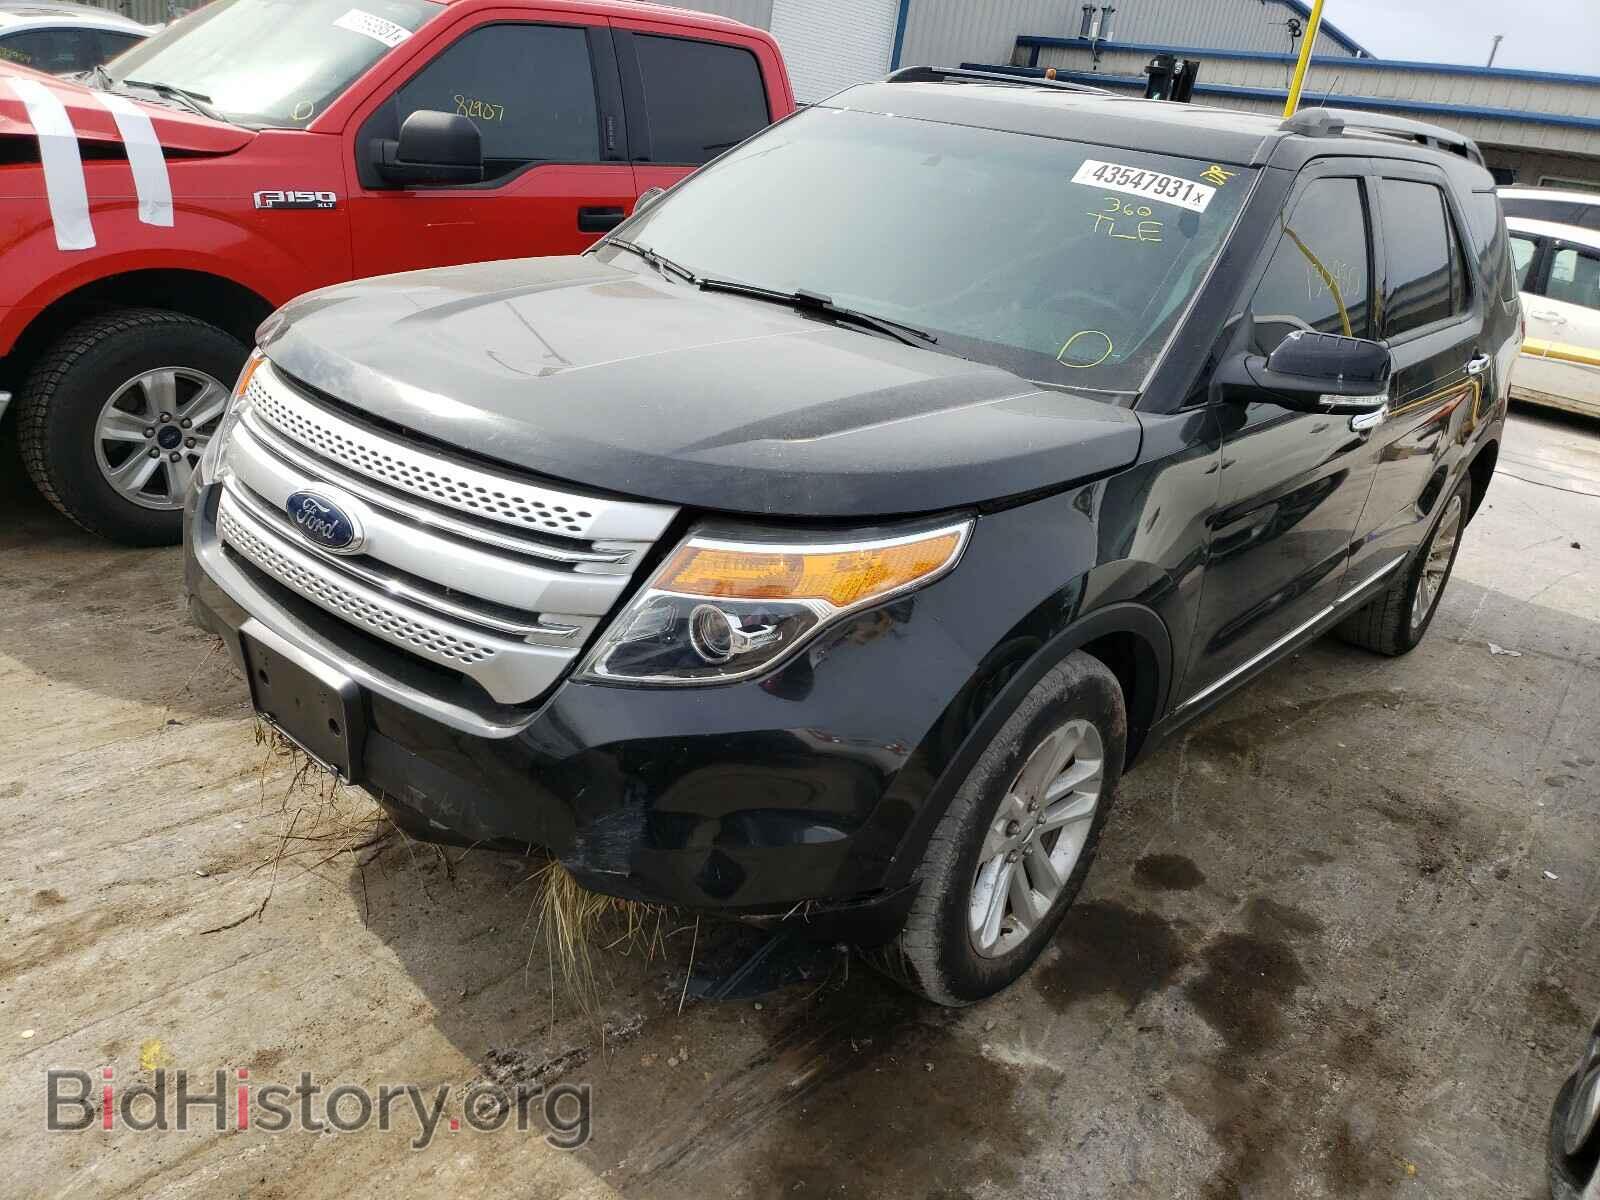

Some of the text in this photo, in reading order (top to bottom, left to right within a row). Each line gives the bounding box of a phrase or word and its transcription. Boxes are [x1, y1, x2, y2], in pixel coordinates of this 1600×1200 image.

[1092, 164, 1195, 202] 43547931
[1087, 211, 1164, 242] TLE
[296, 497, 339, 539] Ford
